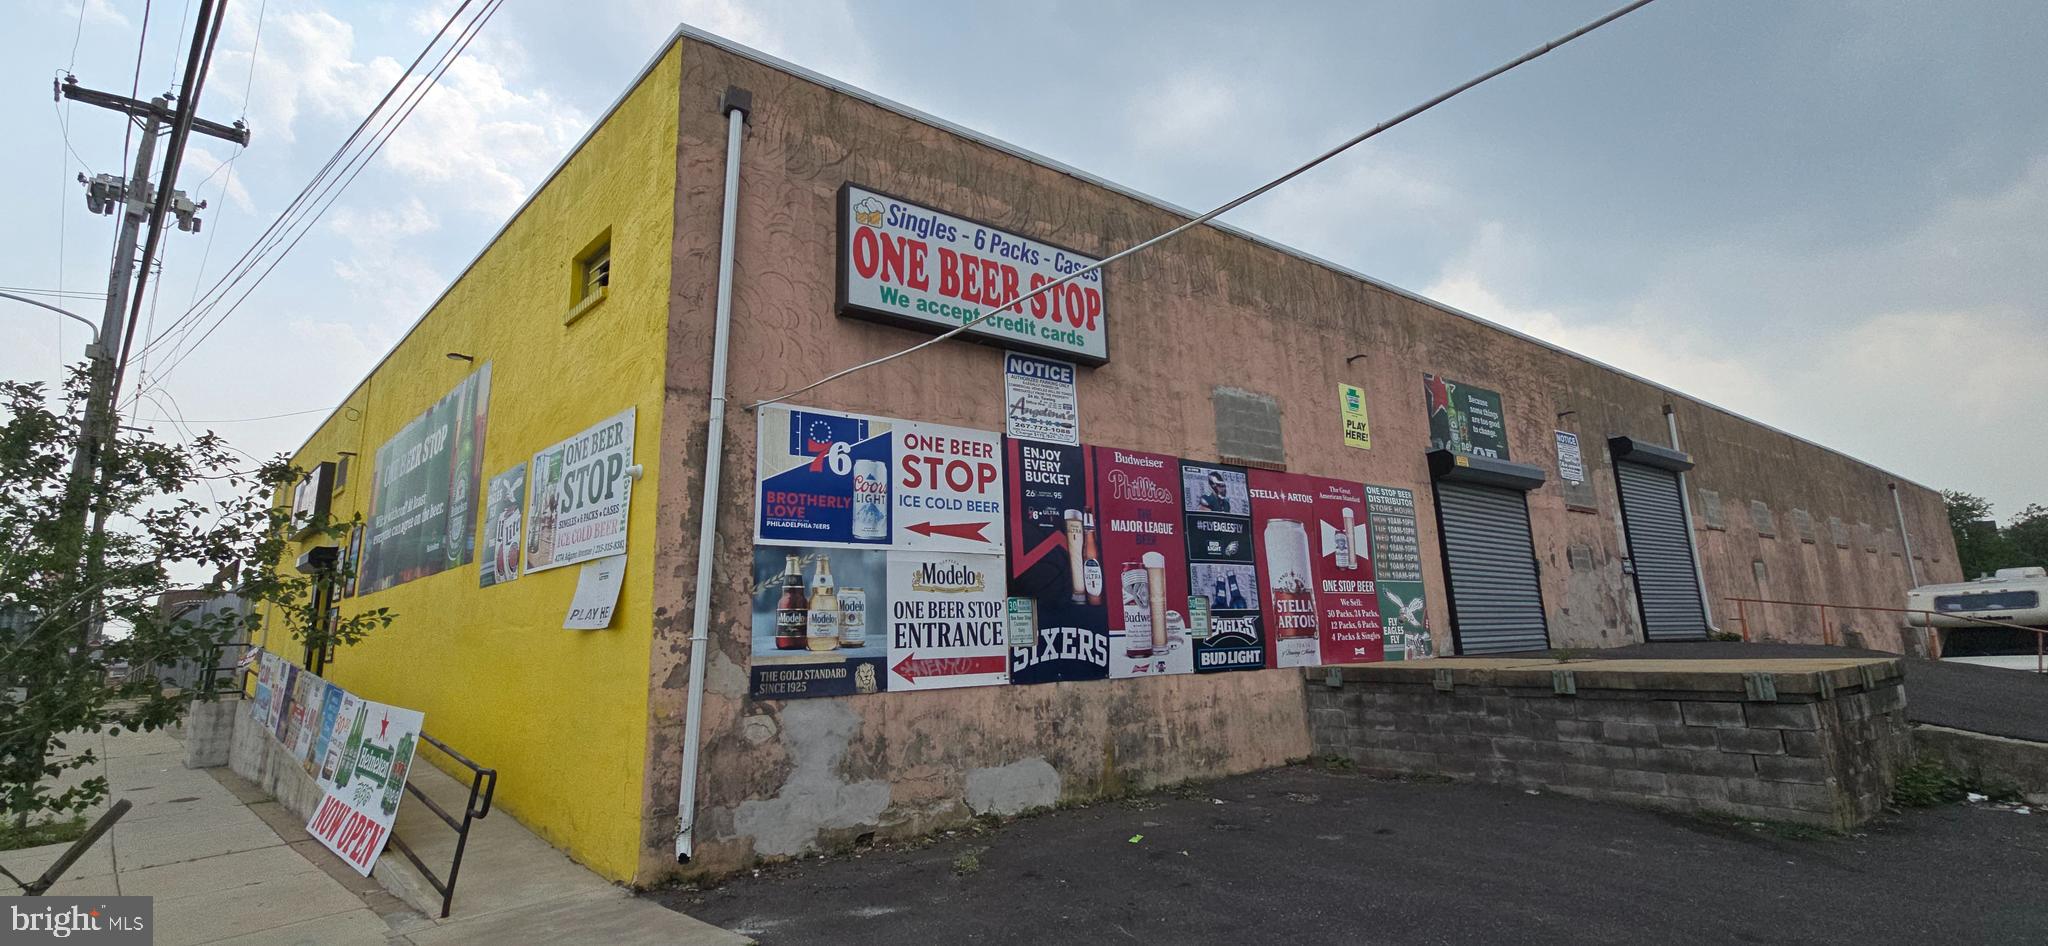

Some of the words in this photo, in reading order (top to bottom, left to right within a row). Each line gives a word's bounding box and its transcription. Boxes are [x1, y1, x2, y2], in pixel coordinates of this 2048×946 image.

[887, 204, 957, 242] Singles
[974, 228, 986, 250] 6
[990, 233, 1040, 266] Packs
[1054, 252, 1099, 282] Cases
[853, 226, 930, 292] ONE
[938, 248, 1022, 314] BEER
[1030, 272, 1100, 332] STOP
[880, 285, 910, 308] We
[916, 298, 980, 325] accept
[986, 313, 1036, 336] credit
[1041, 324, 1085, 346] cards
[1010, 358, 1070, 382] NOTICE
[1346, 420, 1366, 432] PLAY
[422, 424, 448, 463] STOP
[566, 438, 590, 466] ONE
[592, 421, 624, 454] BEER
[1346, 430, 1368, 442] HERE!
[904, 433, 945, 454] ONE
[950, 439, 993, 459] BEER
[1024, 446, 1061, 461] ENJOY
[1024, 459, 1061, 473] EVERY
[1114, 451, 1164, 468] Budweiser
[902, 454, 998, 494] STOP
[1025, 471, 1070, 485] BUCKET
[560, 452, 624, 515] STOP
[854, 474, 888, 494] Coors
[1108, 469, 1173, 504] Phillies
[766, 491, 851, 509] BROTHERLY
[856, 493, 886, 505] LIGHT
[1250, 488, 1279, 500] STELLA
[1288, 492, 1313, 503] ARTOIS
[1366, 486, 1380, 495] ONE
[1380, 488, 1396, 497] STOP
[1397, 490, 1412, 499] BEER
[899, 494, 922, 507] ICE
[926, 497, 962, 511] COLD
[967, 500, 1000, 513] BEER
[1368, 495, 1414, 507] DISTRIBUTOR
[1370, 503, 1393, 512] STORE
[559, 516, 577, 529] SINGLES
[584, 510, 598, 522] PACKS
[603, 504, 620, 516] CASES
[766, 504, 806, 518] LOVE
[766, 520, 812, 529] PHILADELPHIA
[1111, 519, 1144, 533] MAJOR
[1145, 522, 1174, 534] LEAGUE
[557, 532, 570, 548] ICE
[571, 525, 592, 544] COLD
[594, 519, 618, 539] BEER
[922, 562, 976, 586] Modelo
[1322, 580, 1337, 592] ONE
[1338, 580, 1356, 592] STOP
[1358, 581, 1374, 592] BEER
[839, 600, 864, 611] Modelo
[894, 601, 926, 620] ONE
[928, 601, 966, 619] BEER
[967, 600, 1002, 619] STOP
[1277, 599, 1313, 613] STELLA
[570, 607, 599, 620] PLAY
[780, 612, 804, 623] Modelo
[812, 613, 835, 624] Modelo
[1279, 614, 1315, 628] ARTOIS
[1210, 616, 1259, 639] EAGLES
[1388, 618, 1397, 626] FLY
[894, 622, 1004, 648] ENTRANCE
[1337, 632, 1355, 641] Packs
[1361, 631, 1380, 641] Singles
[1383, 626, 1404, 635] EAGLES
[1391, 635, 1400, 644] FLY
[1201, 652, 1227, 666] BUD
[1227, 649, 1261, 664] LIGHT
[760, 671, 778, 682] THE
[779, 669, 803, 681] GOLD
[804, 667, 847, 680] STANDARD
[759, 682, 786, 694] SINCE
[787, 682, 807, 692] 1925
[358, 748, 390, 779] Heineken
[311, 794, 351, 842] NOW
[337, 811, 385, 868] OPEN
